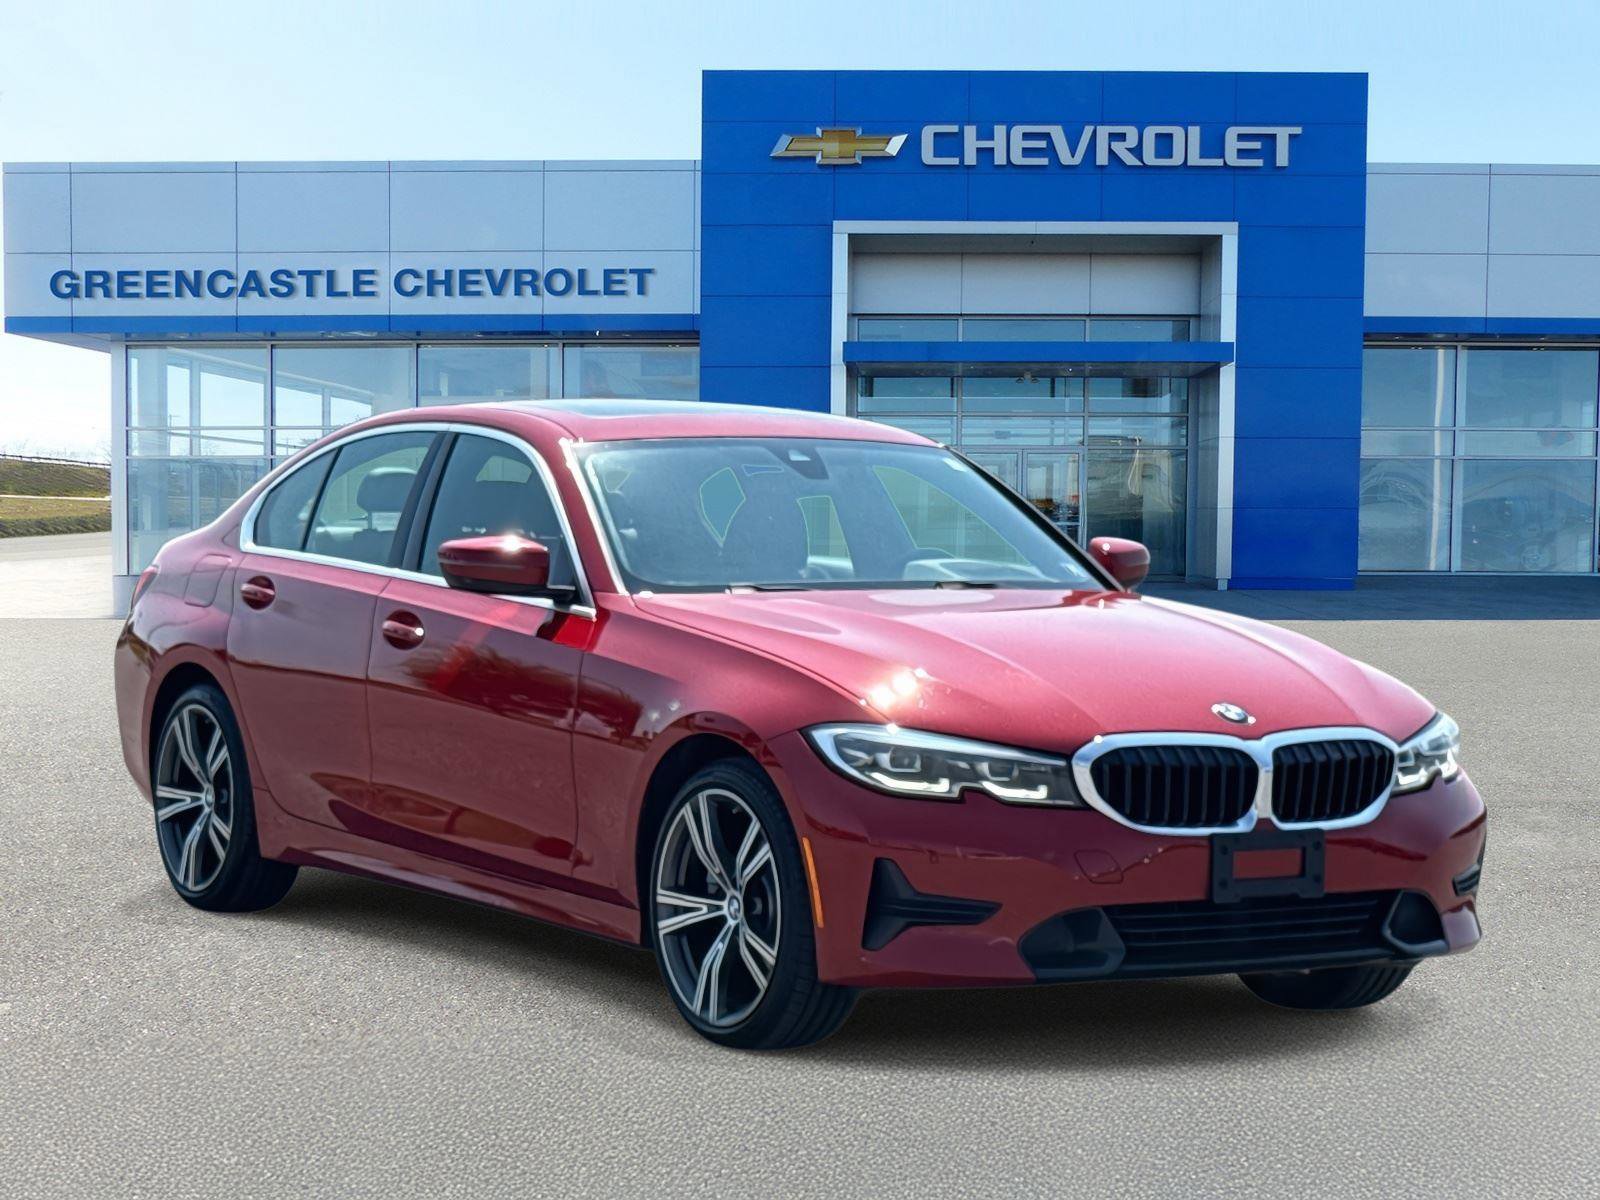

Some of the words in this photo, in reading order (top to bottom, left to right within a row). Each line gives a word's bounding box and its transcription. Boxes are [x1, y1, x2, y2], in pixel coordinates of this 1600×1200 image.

[921, 124, 1303, 168] CHEVROLET
[49, 268, 378, 299] GREENCASTLE
[393, 267, 655, 297] CHEVROLET
